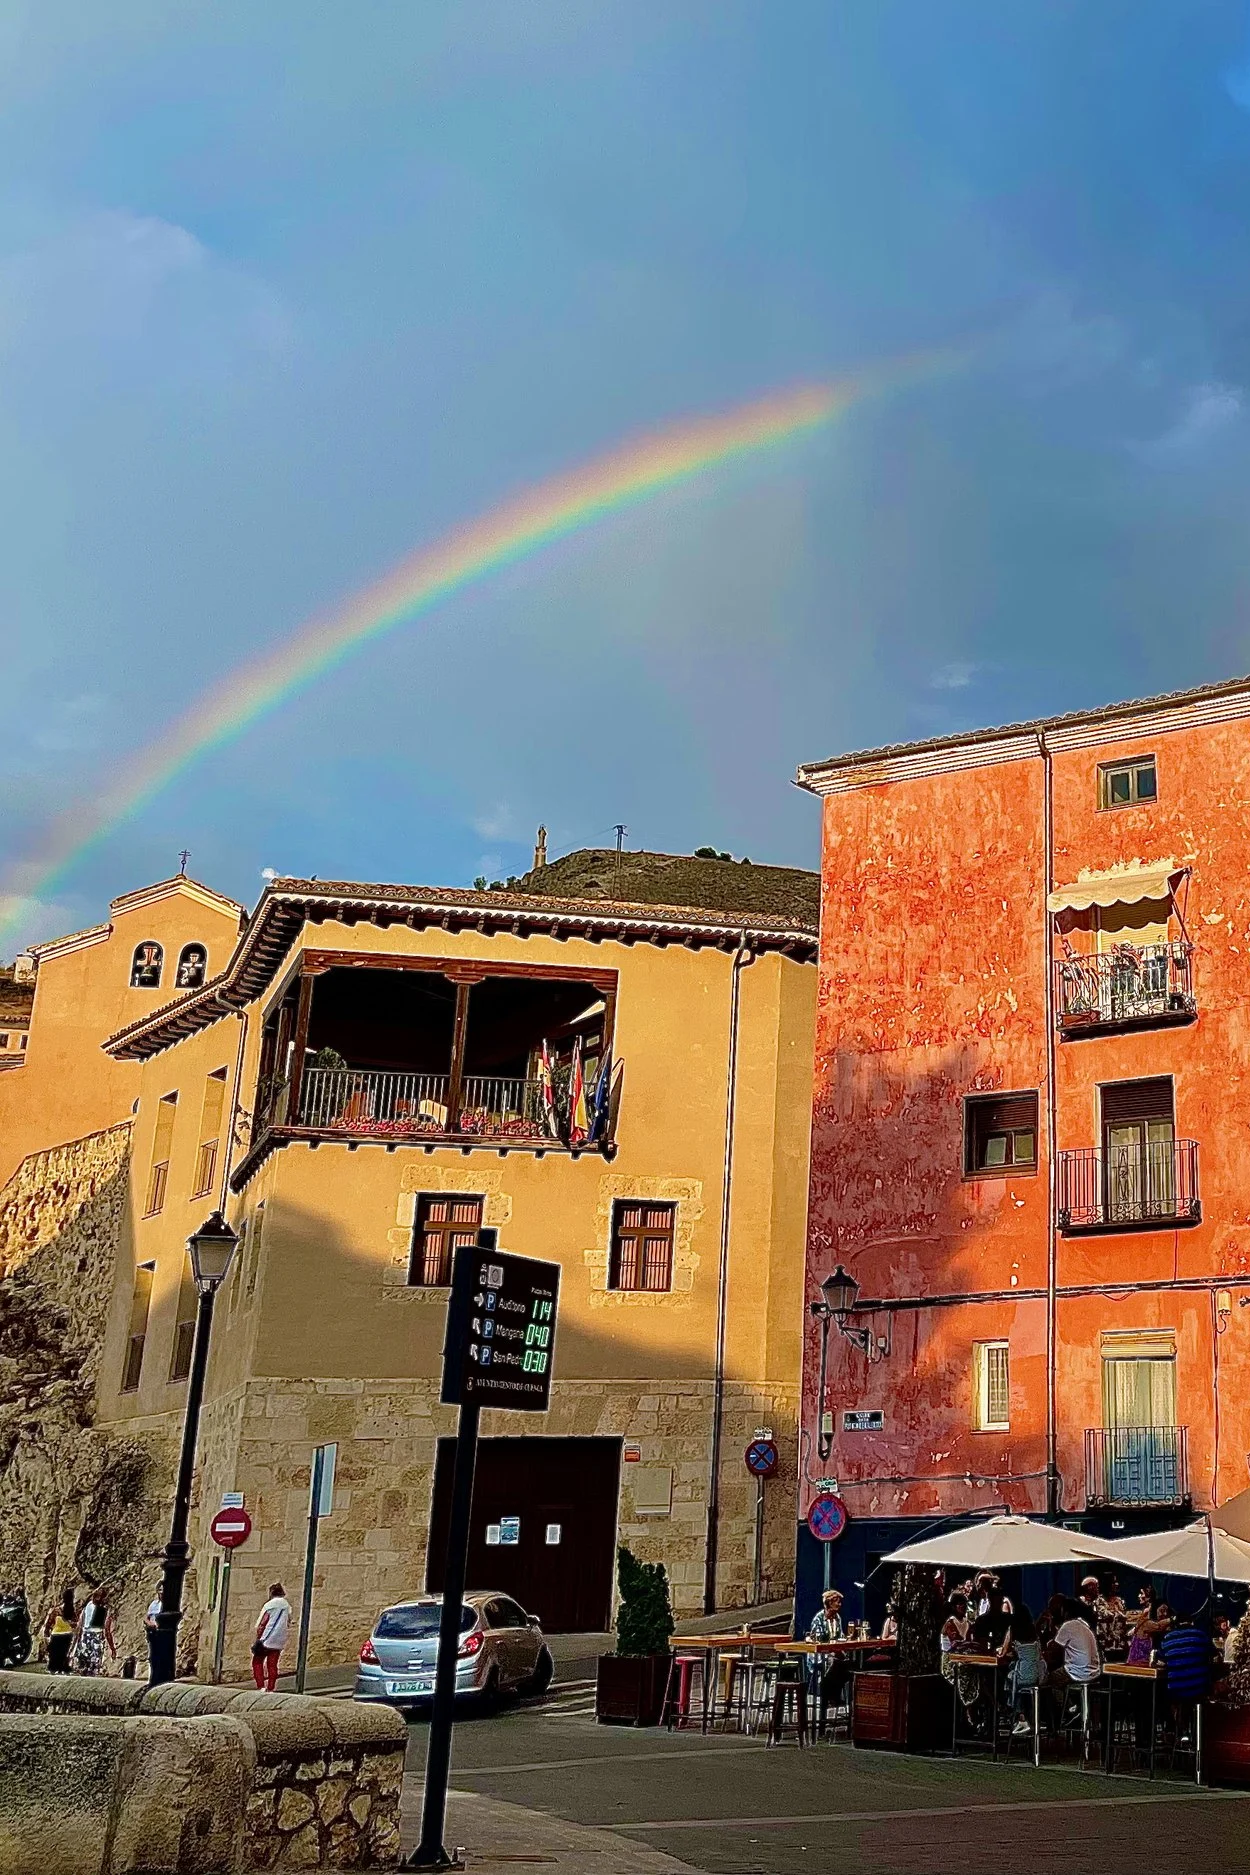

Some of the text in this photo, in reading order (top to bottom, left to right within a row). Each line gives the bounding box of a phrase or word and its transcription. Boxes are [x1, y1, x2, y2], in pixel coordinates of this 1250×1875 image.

[532, 1299, 552, 1321] 114
[495, 1324, 525, 1340] Mangana
[525, 1323, 550, 1347] 040
[523, 1349, 547, 1373] 030
